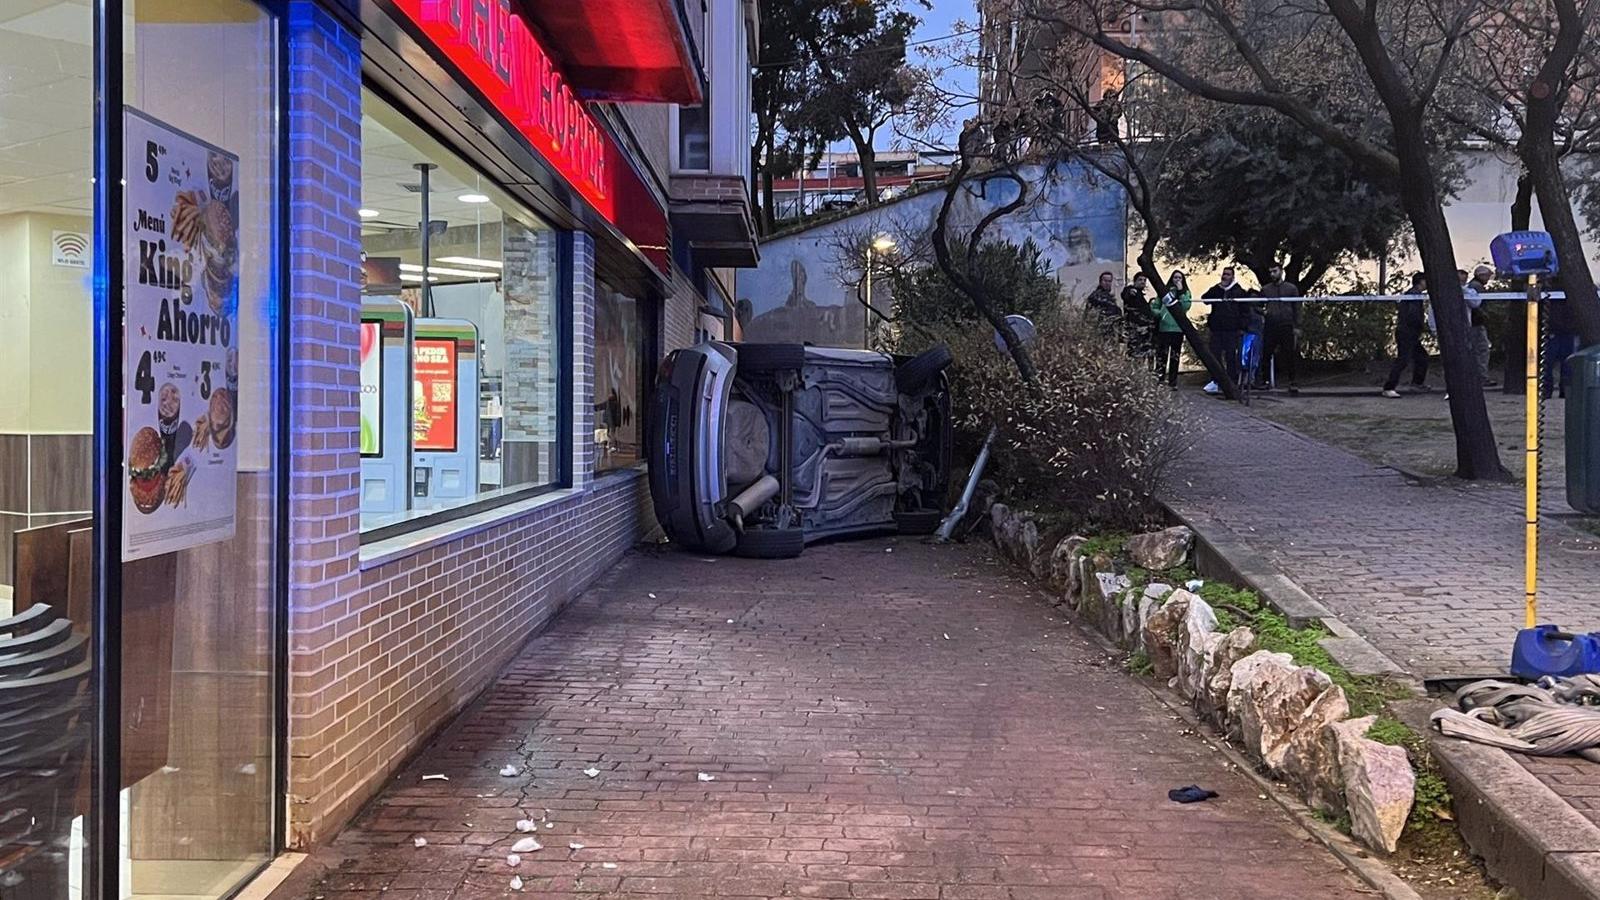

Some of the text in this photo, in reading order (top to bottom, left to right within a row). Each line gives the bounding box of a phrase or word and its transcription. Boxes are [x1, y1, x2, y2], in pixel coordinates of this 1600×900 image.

[146, 140, 158, 183] 5
[134, 209, 165, 234] Menú
[139, 239, 193, 305] King
[157, 298, 231, 347] Ahorro
[135, 350, 155, 404] 4
[200, 361, 211, 400] 3
